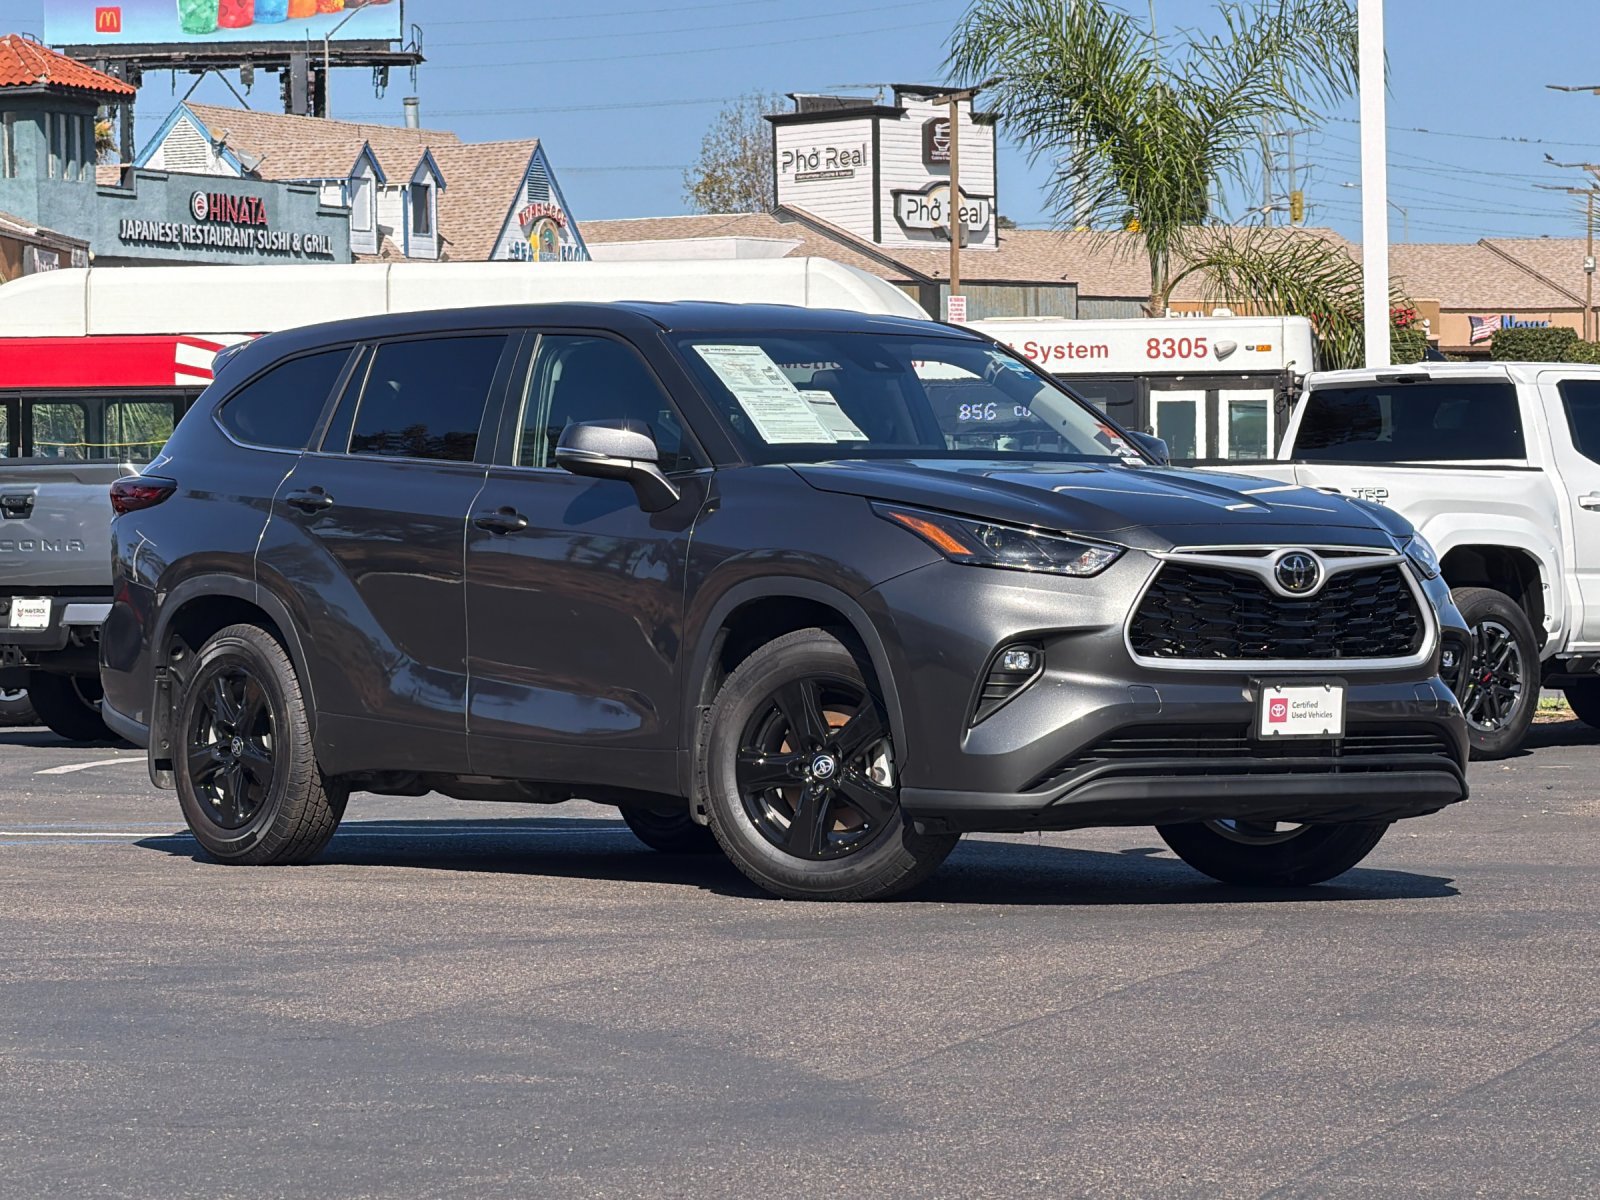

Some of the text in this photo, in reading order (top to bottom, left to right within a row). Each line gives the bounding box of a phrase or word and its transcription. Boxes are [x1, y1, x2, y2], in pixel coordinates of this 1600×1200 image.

[826, 143, 866, 169] Real
[209, 192, 267, 225] HINATA
[120, 219, 334, 254] JAPANESE RESTAURANT SUSHI & GRILL
[1024, 341, 1109, 364] System
[1146, 338, 1208, 359] 8305
[959, 403, 998, 421] 856
[1350, 487, 1389, 501] TRD
[1291, 711, 1333, 719] Used Vehicles
[1292, 701, 1319, 709] Certified
